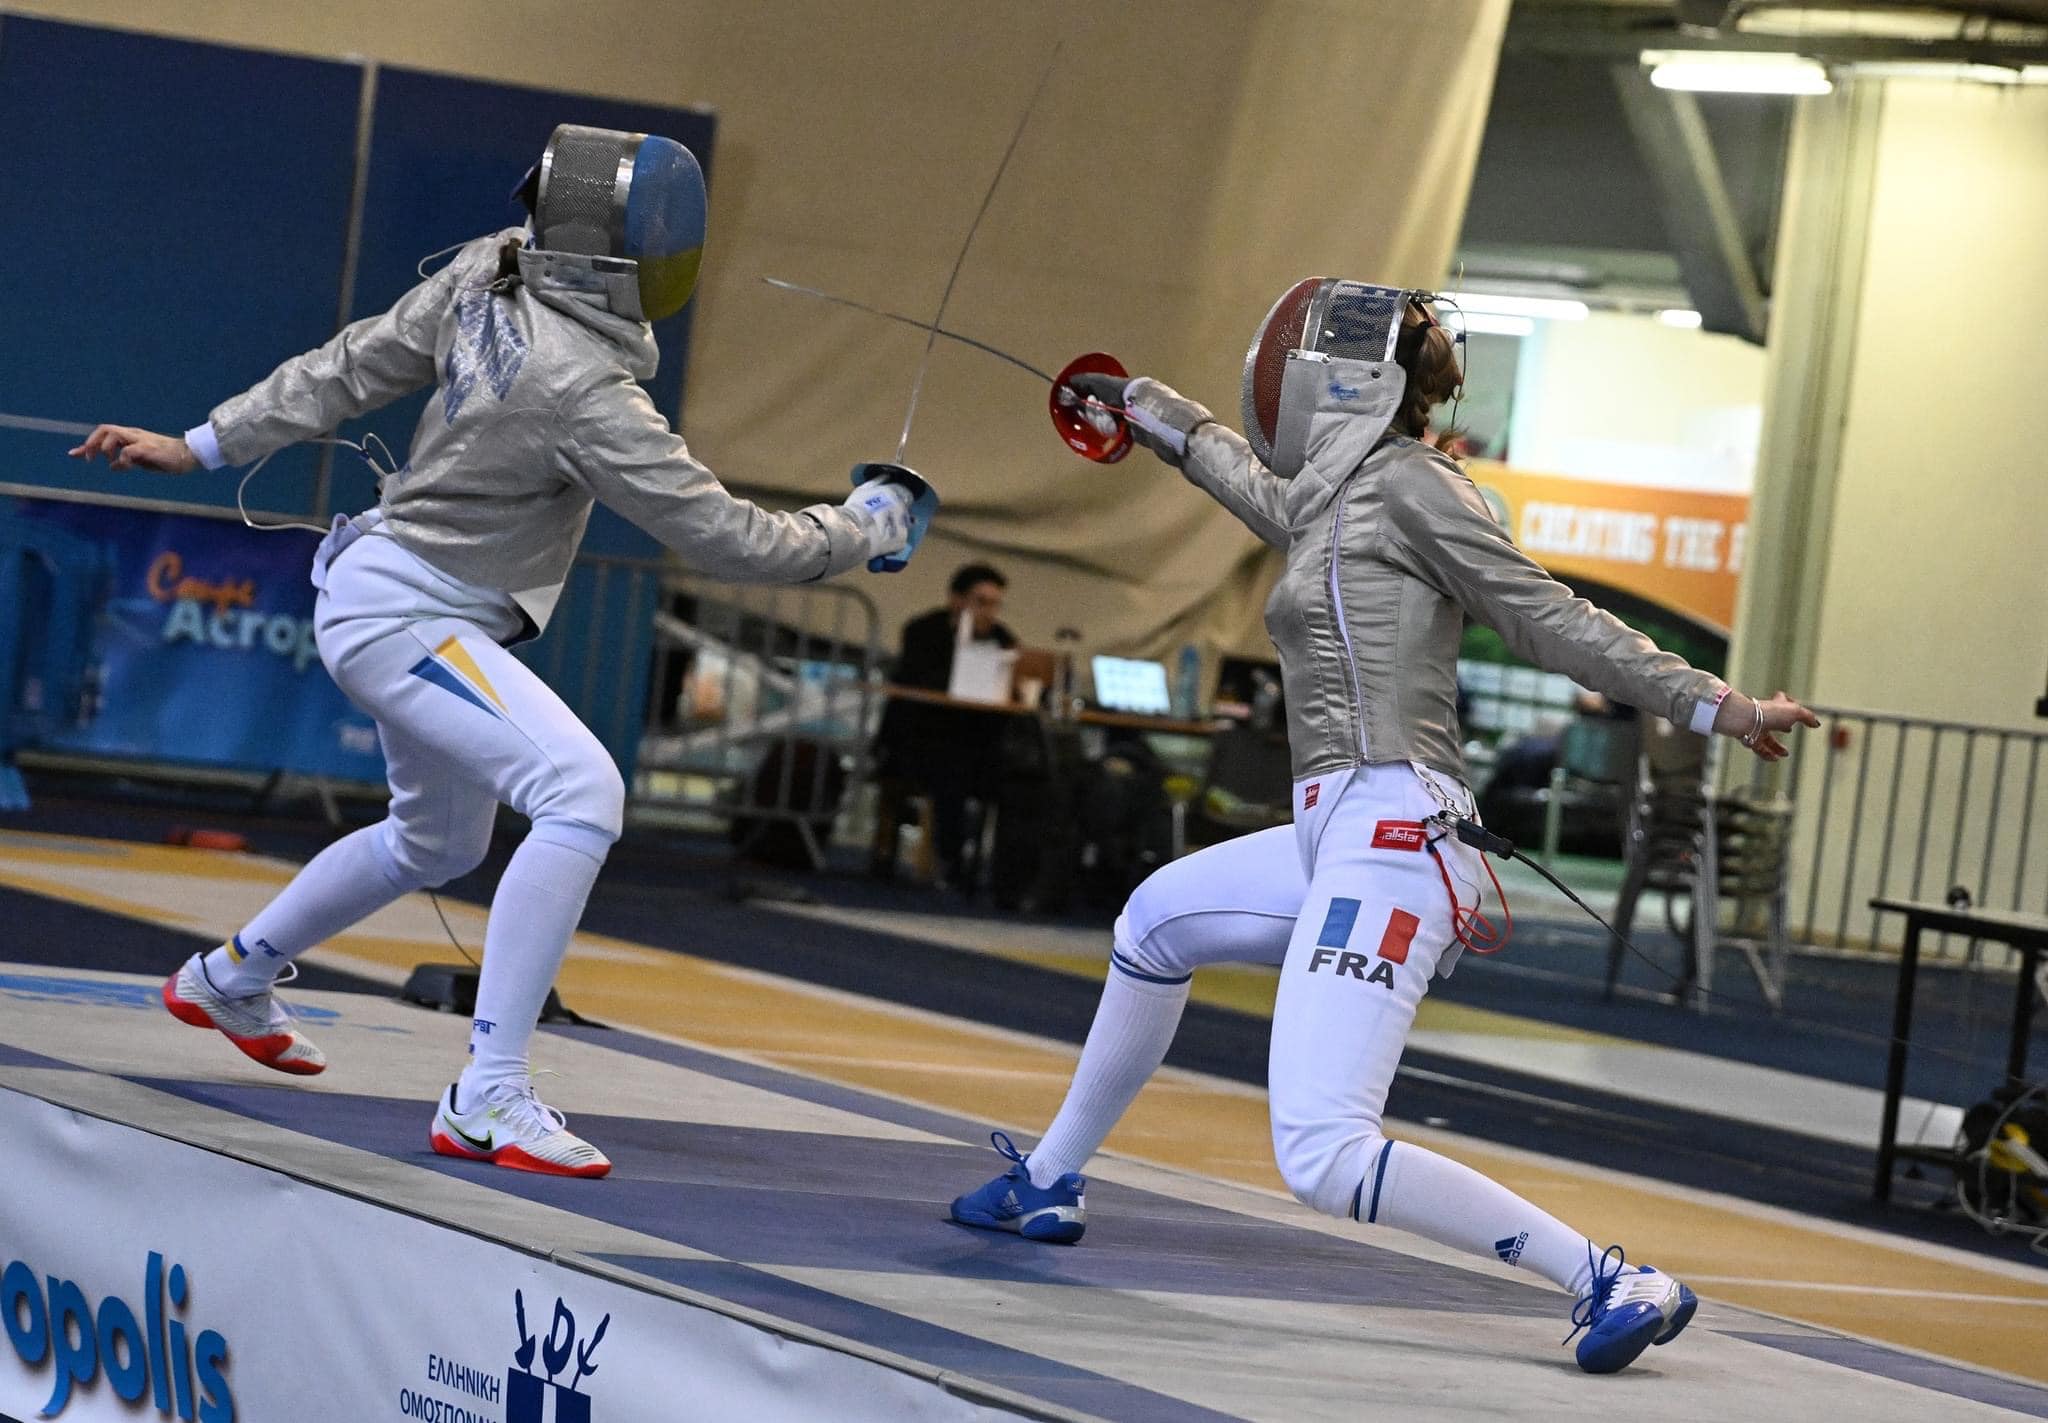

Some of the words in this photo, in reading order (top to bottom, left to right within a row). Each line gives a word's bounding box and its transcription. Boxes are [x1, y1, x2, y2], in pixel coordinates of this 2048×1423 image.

[1384, 827, 1420, 843] allstar
[1308, 948, 1394, 990] FRA
[428, 1354, 500, 1404] ΕΛΛΗΝΙΚΗ
